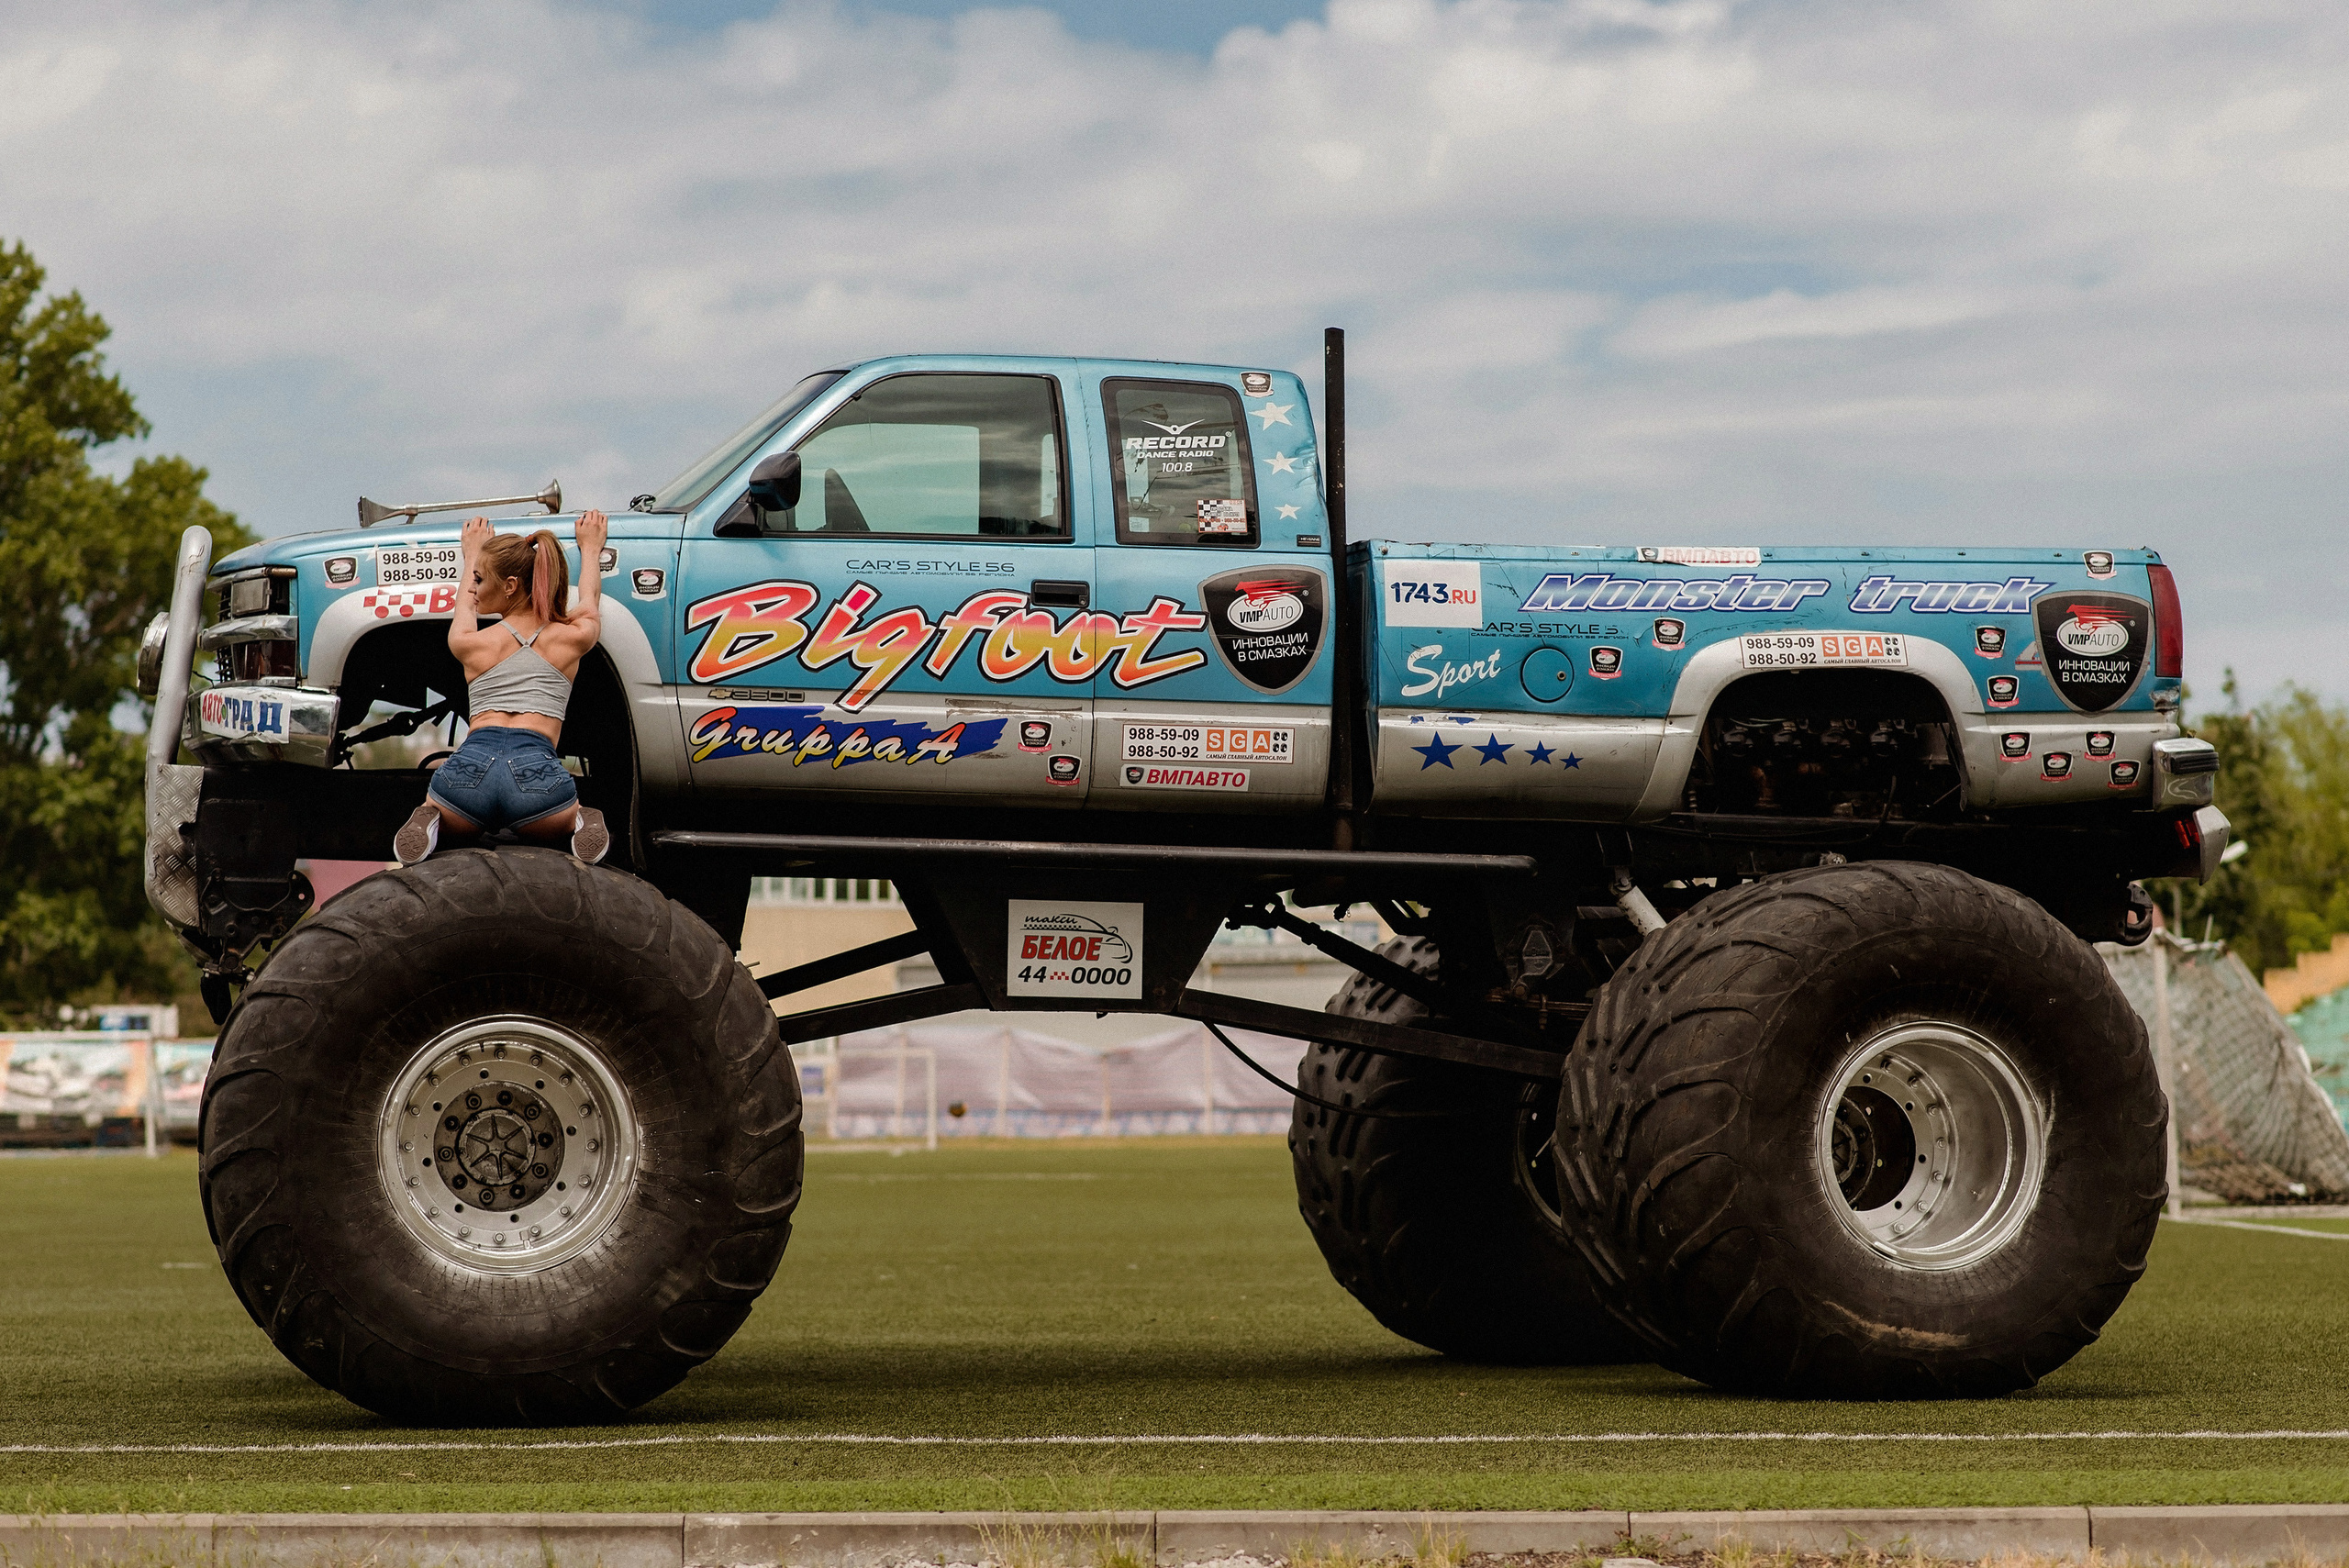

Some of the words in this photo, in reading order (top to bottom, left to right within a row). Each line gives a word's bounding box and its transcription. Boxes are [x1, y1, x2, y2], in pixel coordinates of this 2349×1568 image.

[1126, 436, 1226, 450] RECORD
[1138, 450, 1176, 459] DANCE
[1179, 450, 1214, 458] RADIO
[1162, 462, 1193, 473] 100.8
[383, 550, 456, 565] 988-59-09
[1663, 548, 1757, 563] ВМПАВТО
[846, 559, 911, 571] CAR'S
[916, 561, 981, 572] STYLE
[985, 562, 1016, 573] 56
[384, 567, 457, 582] 988-50-92
[1390, 582, 1476, 604] 1743.RU
[1518, 572, 1831, 613] Monster
[1848, 574, 2056, 614] truck
[1239, 606, 1294, 624] VMPAUTO
[1538, 623, 1600, 635] STYLE
[685, 578, 1208, 714] Bigfoot
[1232, 632, 1308, 650] ИННОВАЦИИ
[1746, 637, 1815, 650] 988-59-09
[1824, 639, 1883, 654] SGA
[2067, 633, 2120, 646] VMPAUTO
[1238, 651, 1247, 662] В
[1248, 645, 1307, 661] СМАЗКАХ
[1749, 652, 1817, 665] 988-50-92
[1401, 644, 1502, 699] Sport
[2058, 660, 2130, 672] ИННОВАЦИИ
[2062, 672, 2070, 683] В
[2072, 673, 2127, 684] СМАЗКАХ
[1129, 728, 1200, 740] 988-59-09
[1208, 732, 1269, 750] SGA
[1128, 745, 1199, 758] 988-50-92
[1147, 769, 1246, 787] ВМПАВТО
[1024, 916, 1078, 925] такси
[1020, 935, 1104, 962] БЕЛОЕ
[1018, 965, 1047, 984] 44
[1071, 966, 1132, 985] 0000
